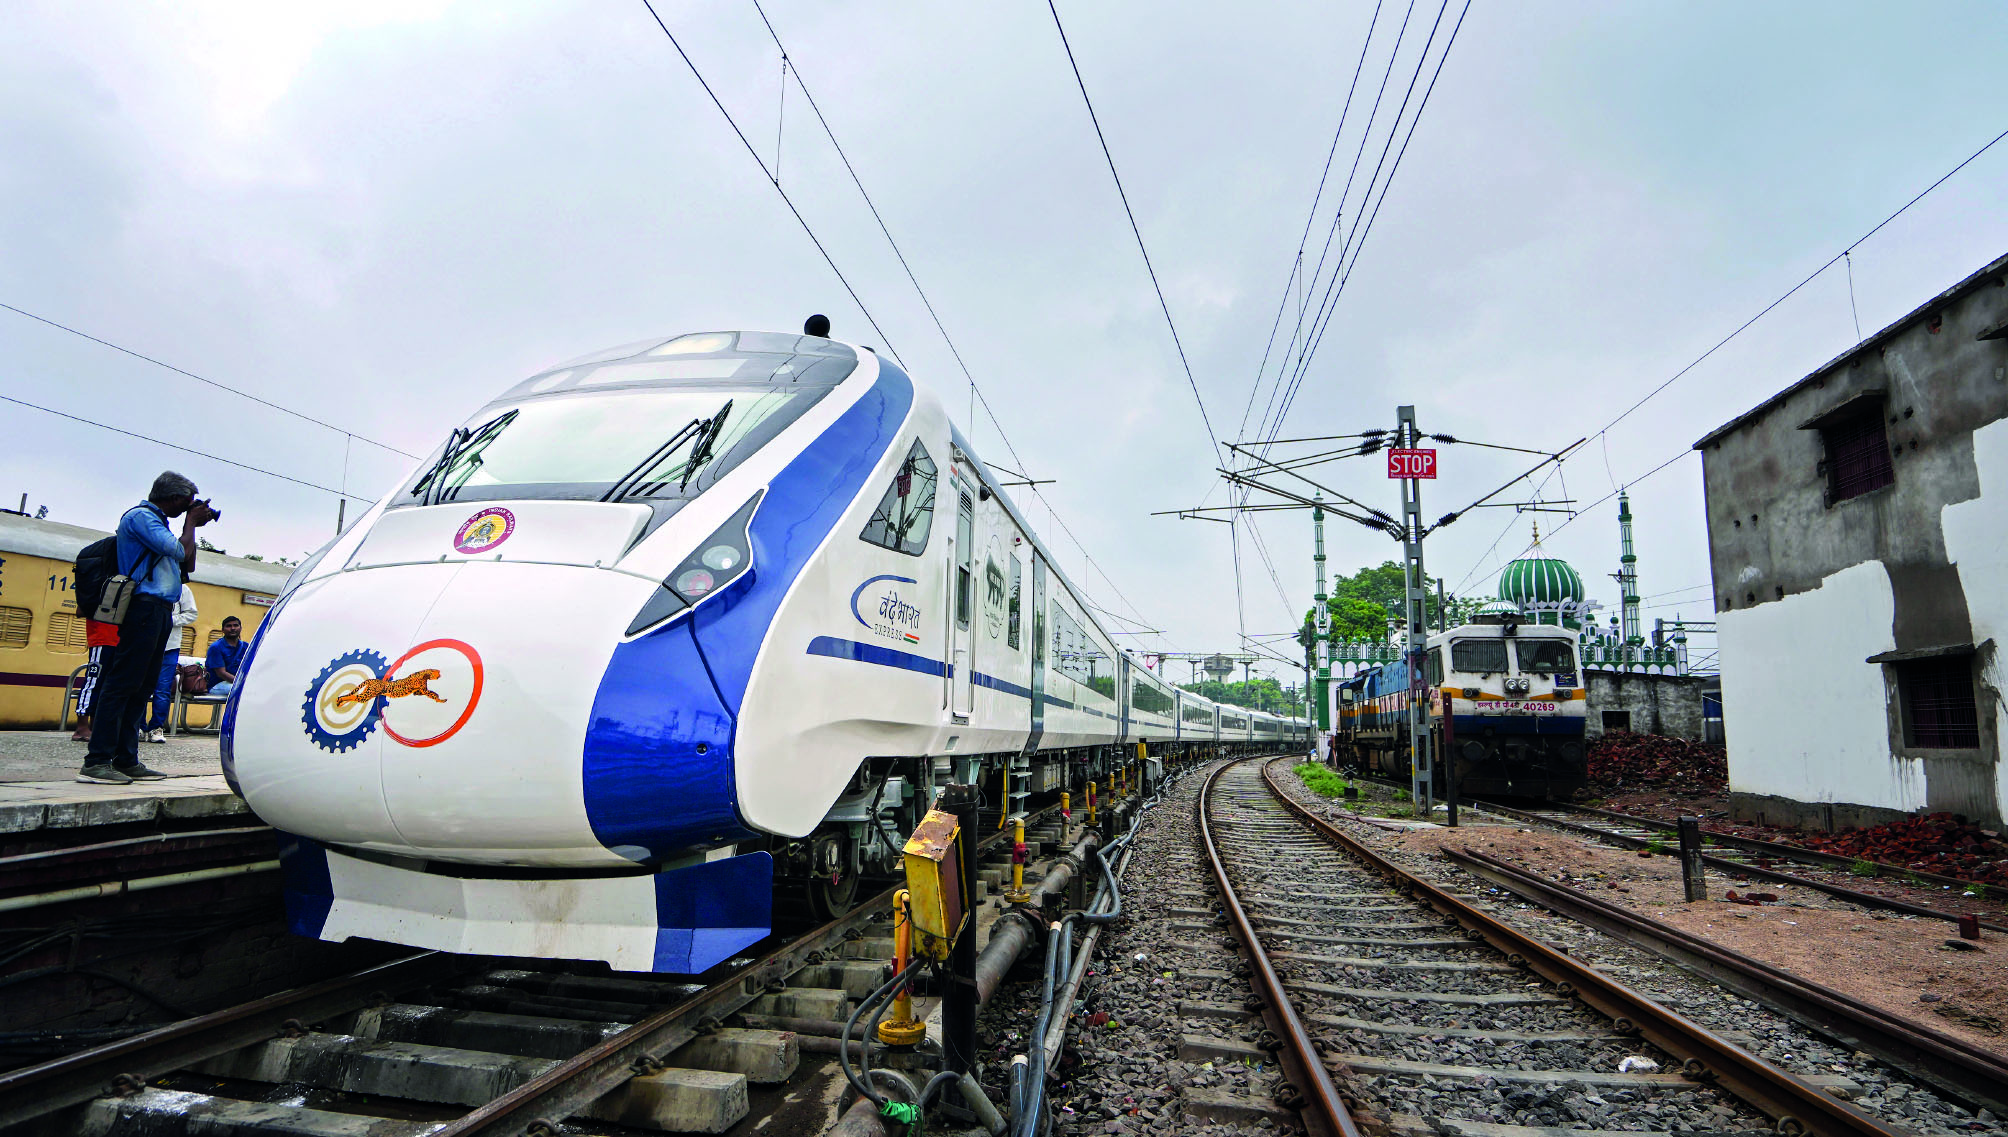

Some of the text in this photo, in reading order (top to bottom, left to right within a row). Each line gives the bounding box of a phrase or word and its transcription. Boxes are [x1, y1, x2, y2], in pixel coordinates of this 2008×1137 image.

[1391, 455, 1432, 473] STOP
[880, 590, 920, 629] वंदे भारत
[874, 623, 902, 640] EXPRESS
[1523, 702, 1555, 711] 40269
